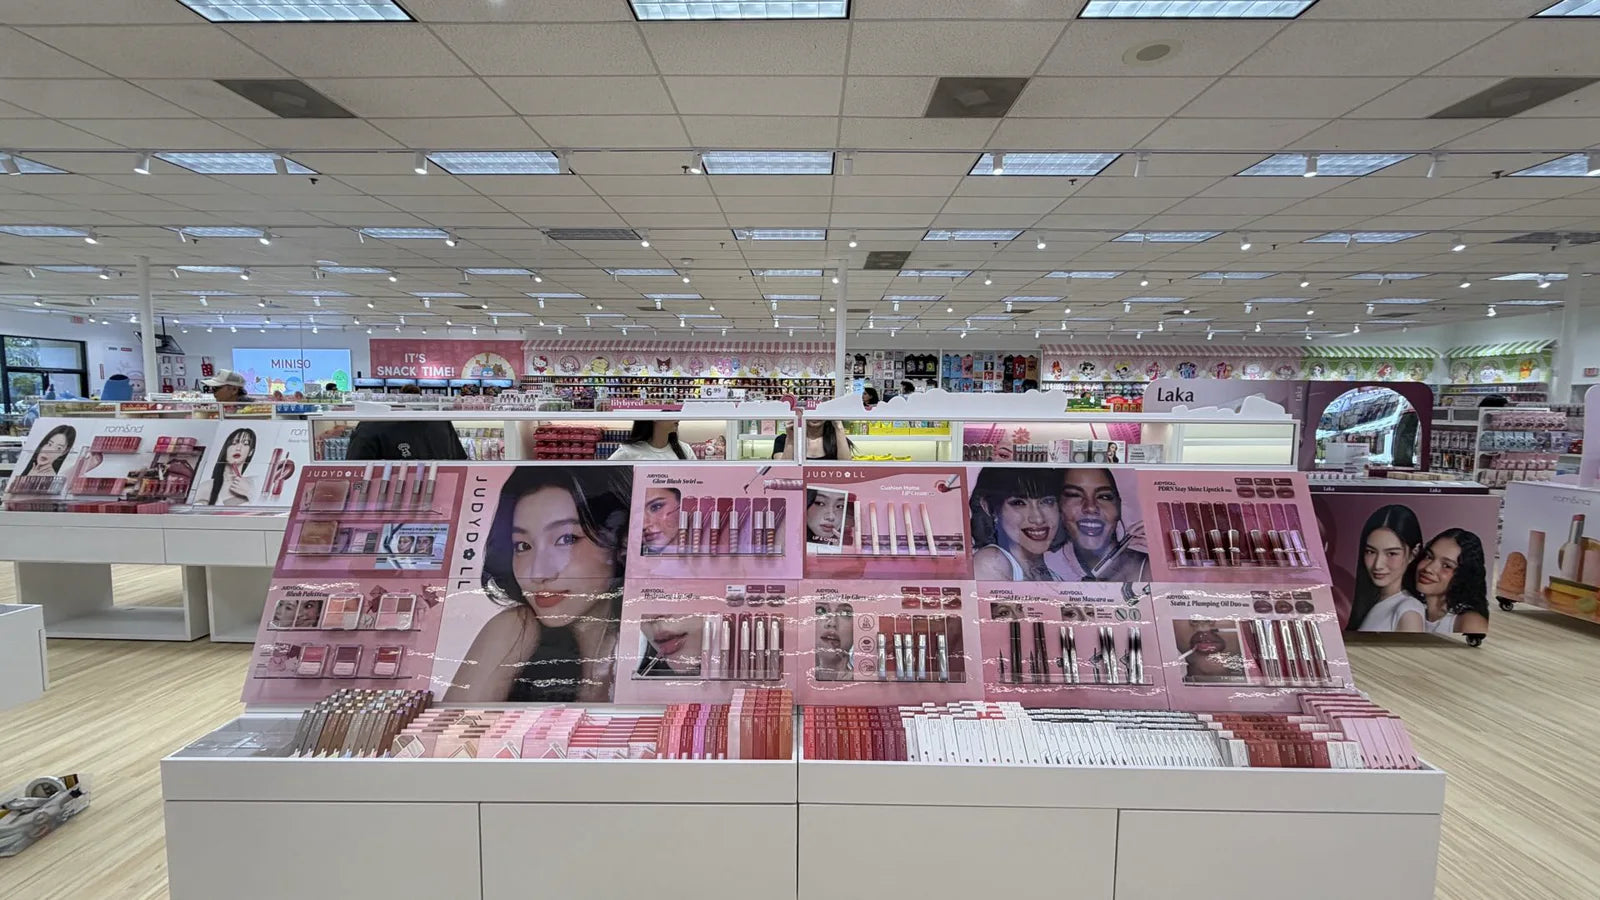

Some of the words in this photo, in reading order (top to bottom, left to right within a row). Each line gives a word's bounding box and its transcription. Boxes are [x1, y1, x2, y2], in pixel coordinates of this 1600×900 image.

[404, 353, 426, 363] IT'S
[271, 359, 311, 369] MINISO
[377, 366, 417, 376] SNACK
[421, 367, 455, 377] TIME!
[1157, 387, 1194, 402] Laka
[611, 399, 643, 408] lilybyred
[104, 424, 144, 433] rom&nd
[458, 475, 488, 589] JUDYDOLL
[1192, 600, 1220, 608] Plumping
